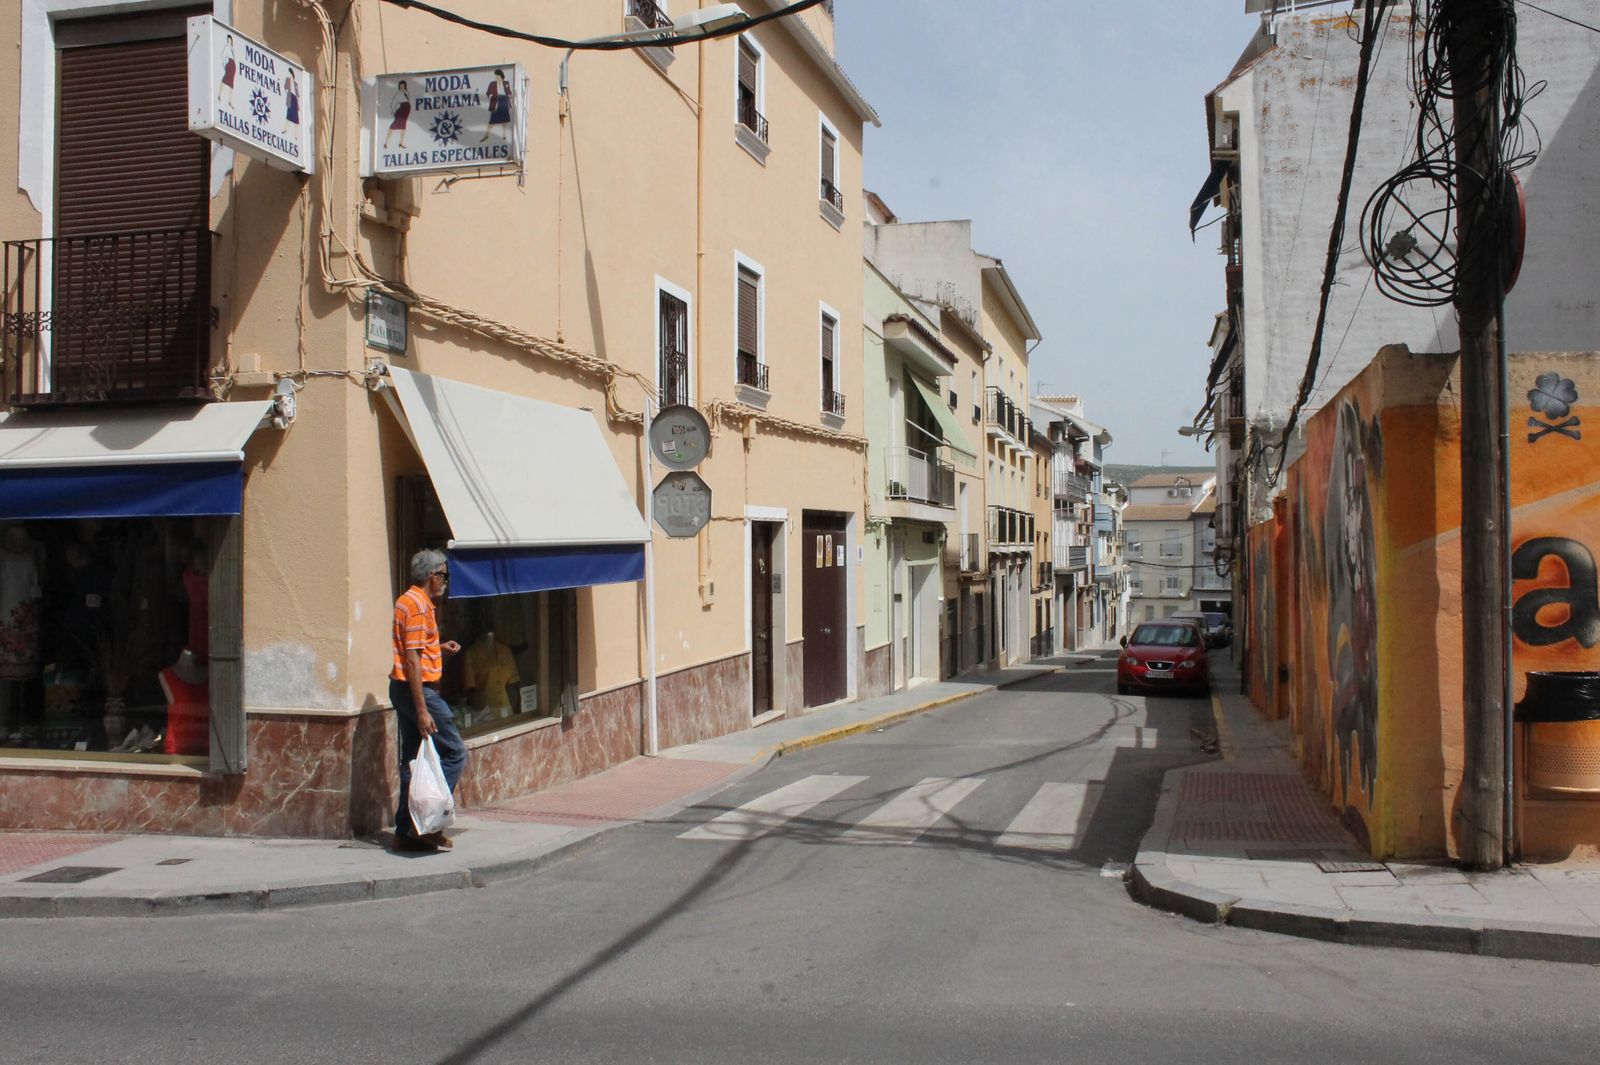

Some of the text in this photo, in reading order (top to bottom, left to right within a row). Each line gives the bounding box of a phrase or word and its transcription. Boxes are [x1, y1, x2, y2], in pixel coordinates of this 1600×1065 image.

[245, 44, 276, 76] MODA
[239, 62, 282, 97] PREMAMÁ
[425, 74, 472, 93] MODA
[415, 88, 481, 111] PREMAMÁ
[218, 109, 299, 158] TALLAS ESPECIALES
[383, 144, 509, 168] TALLAS ESPECIALES
